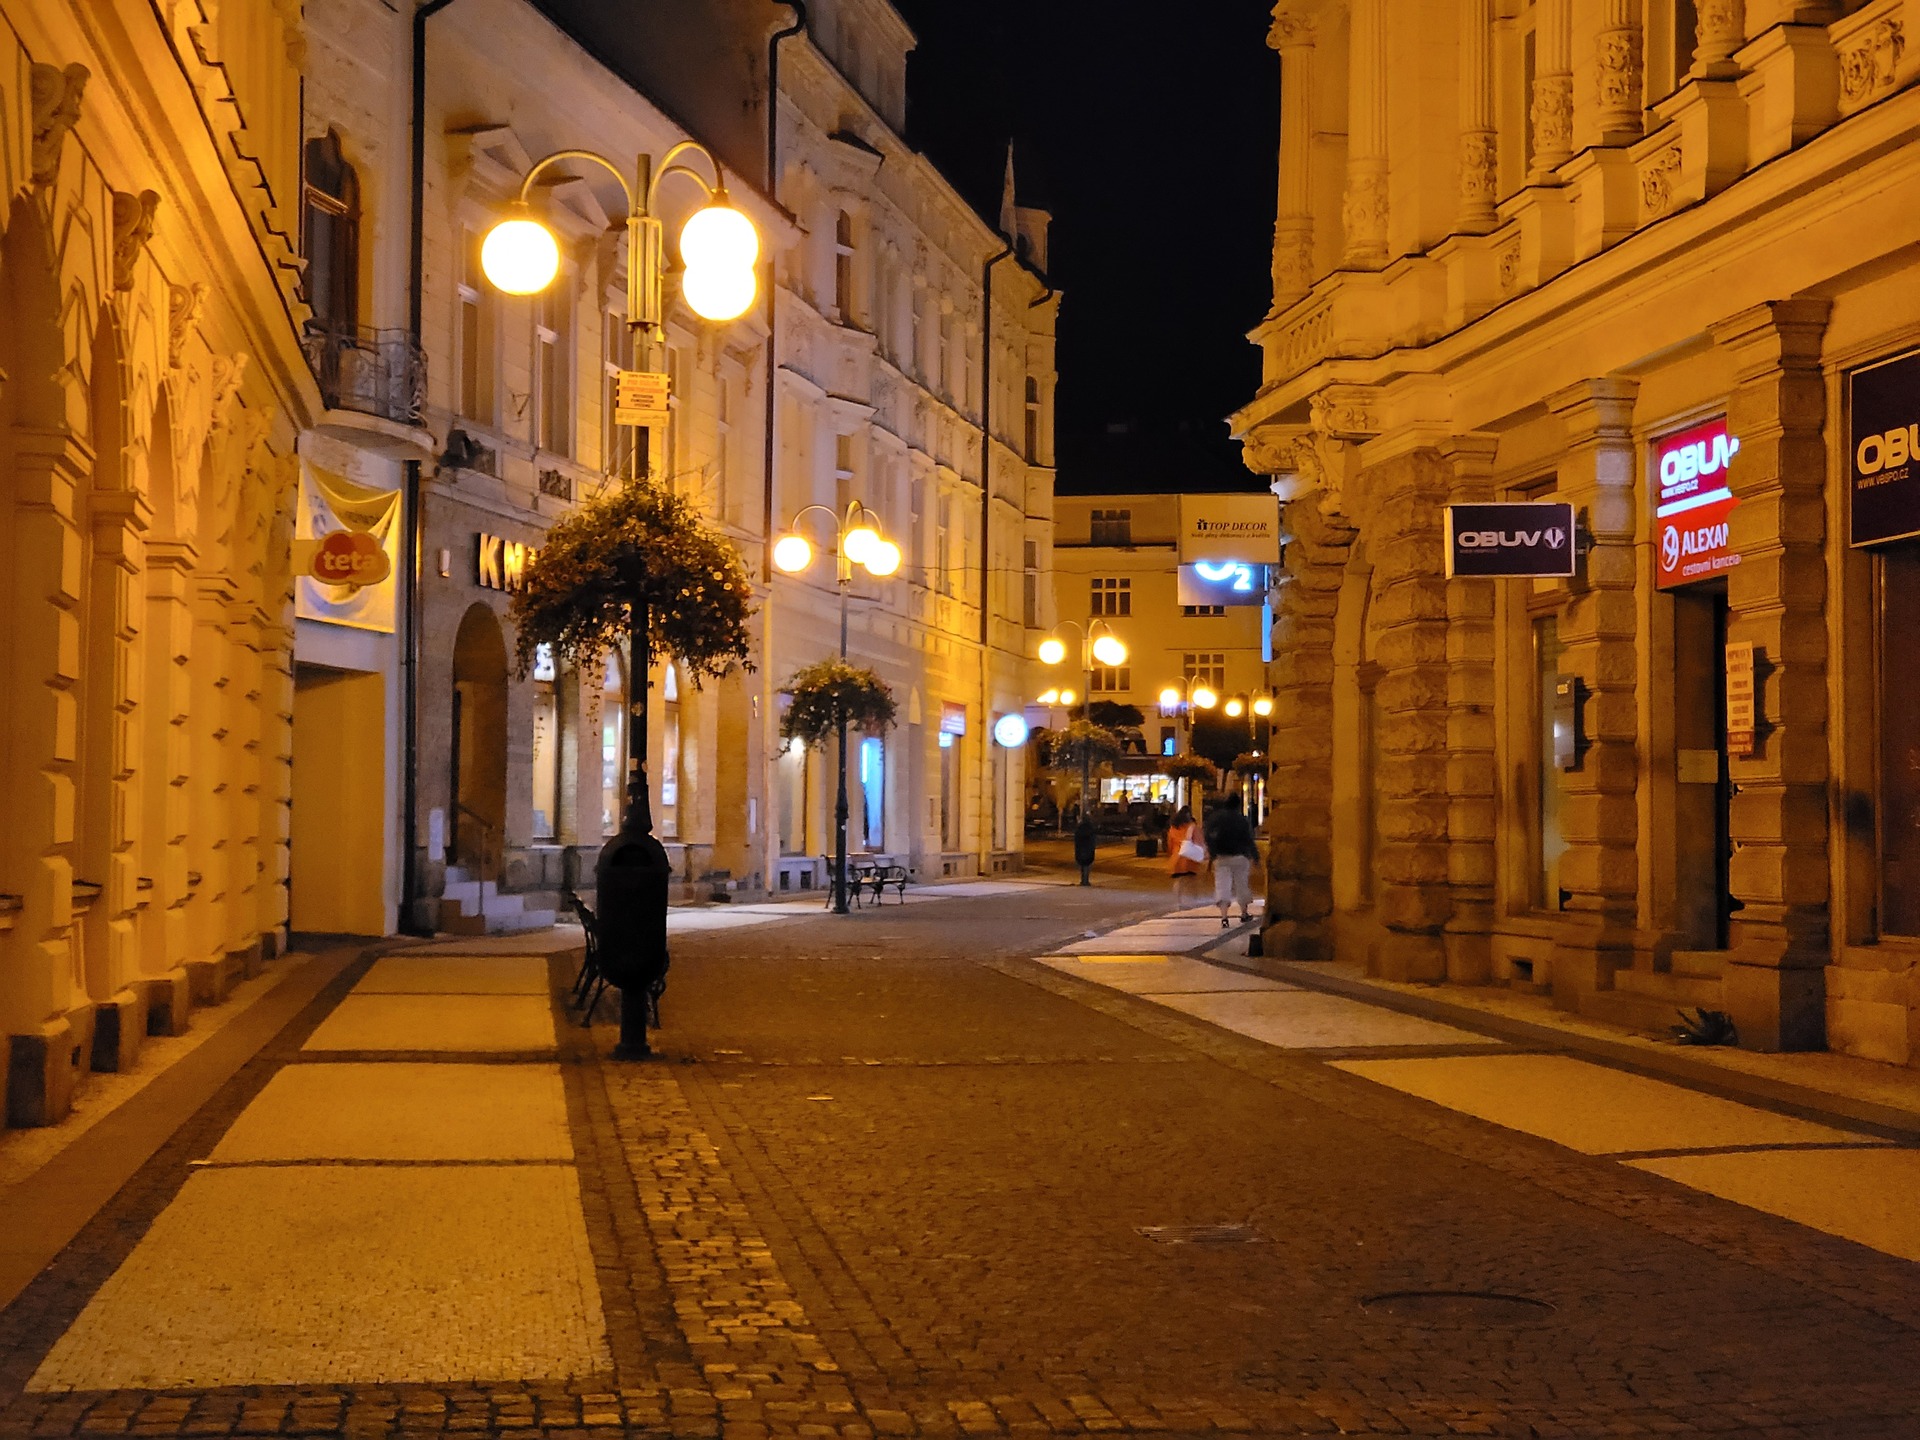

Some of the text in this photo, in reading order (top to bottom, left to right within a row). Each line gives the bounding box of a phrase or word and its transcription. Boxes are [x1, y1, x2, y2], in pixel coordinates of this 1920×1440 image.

[1661, 434, 1740, 486] OBUV
[1209, 522, 1267, 531] TOP DECOR
[1458, 530, 1542, 548] OBUV
[322, 550, 377, 572] teta
